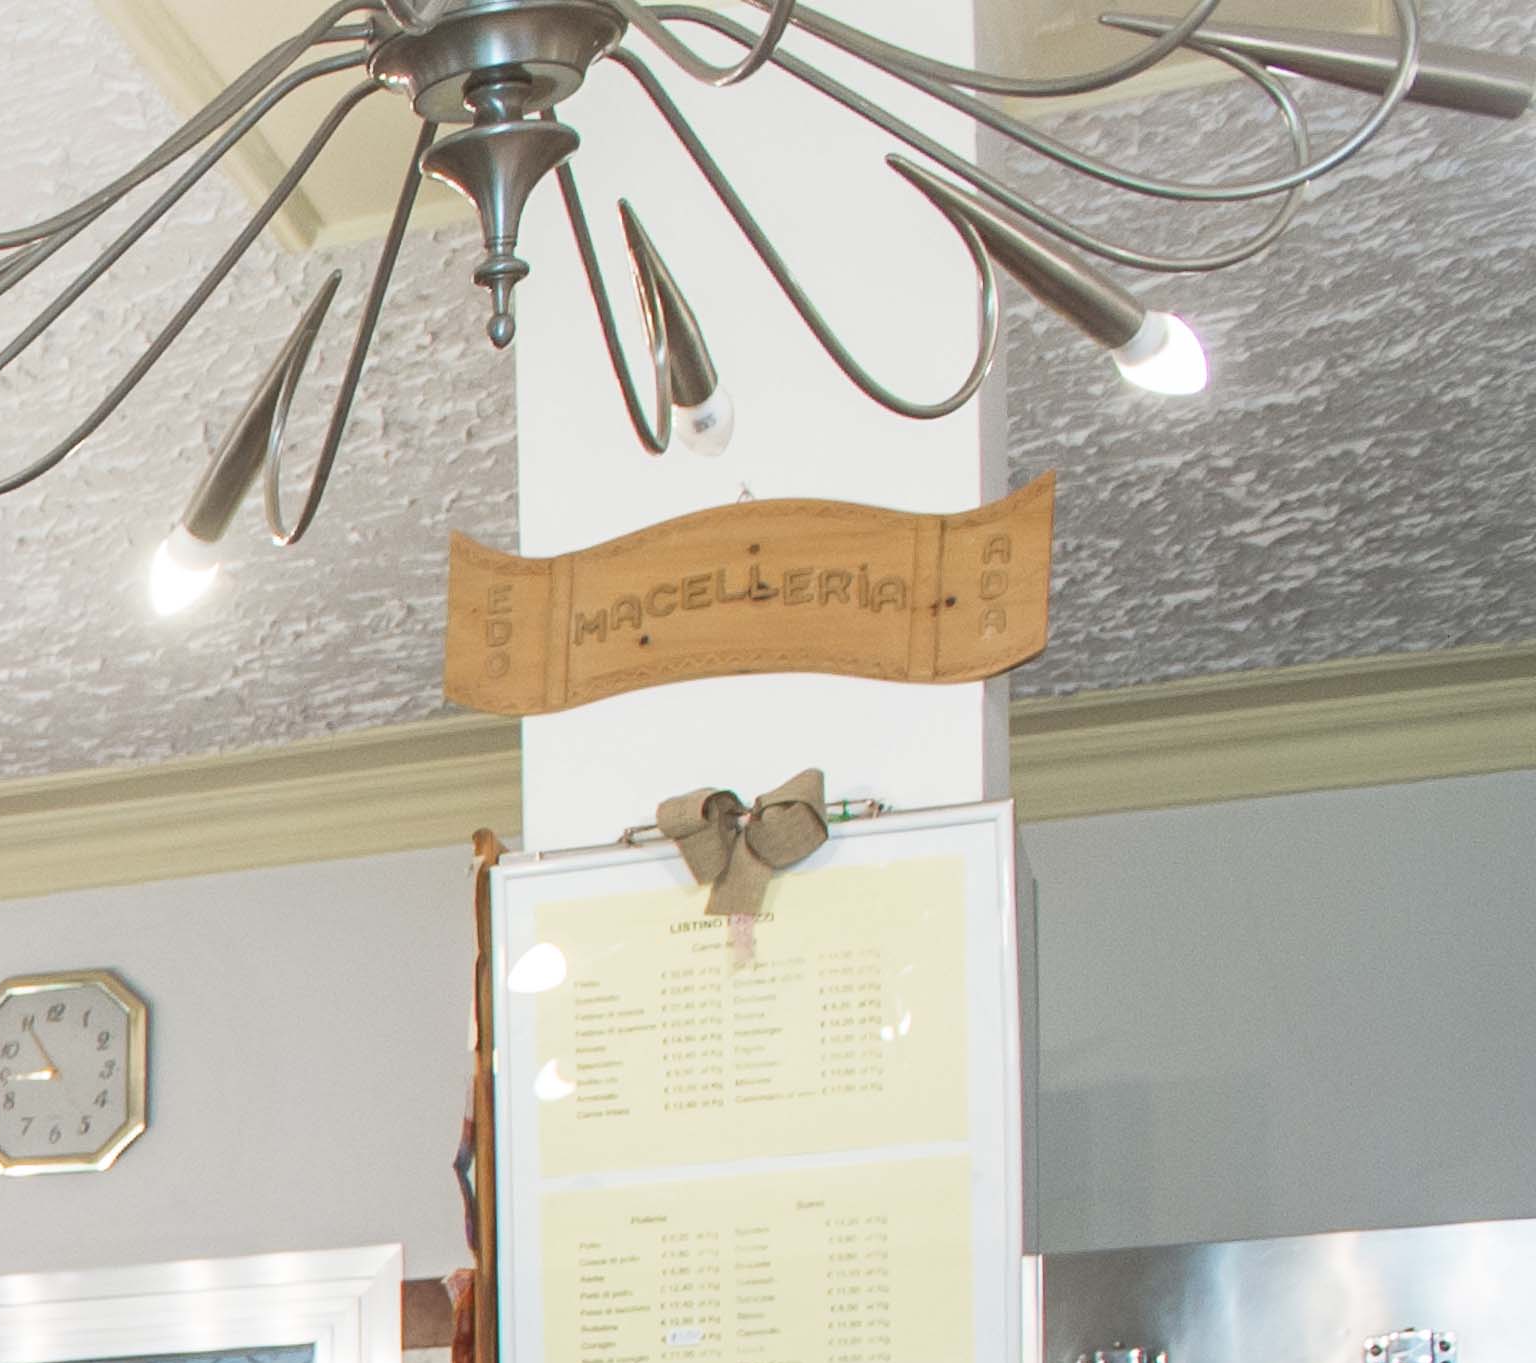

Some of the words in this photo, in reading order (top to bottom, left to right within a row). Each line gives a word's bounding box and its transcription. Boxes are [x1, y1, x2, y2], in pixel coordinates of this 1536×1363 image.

[979, 533, 1012, 635] ADA
[574, 563, 908, 646] MACELLERIA
[46, 1002, 67, 1022] 12
[96, 1031, 110, 1051] 2
[0, 1043, 20, 1060] 10
[99, 1059, 117, 1080] 3
[2, 1091, 16, 1110] 8
[93, 1090, 110, 1109] 4
[20, 1116, 35, 1136] 7
[48, 1124, 63, 1144] 6
[77, 1115, 91, 1136] 5
